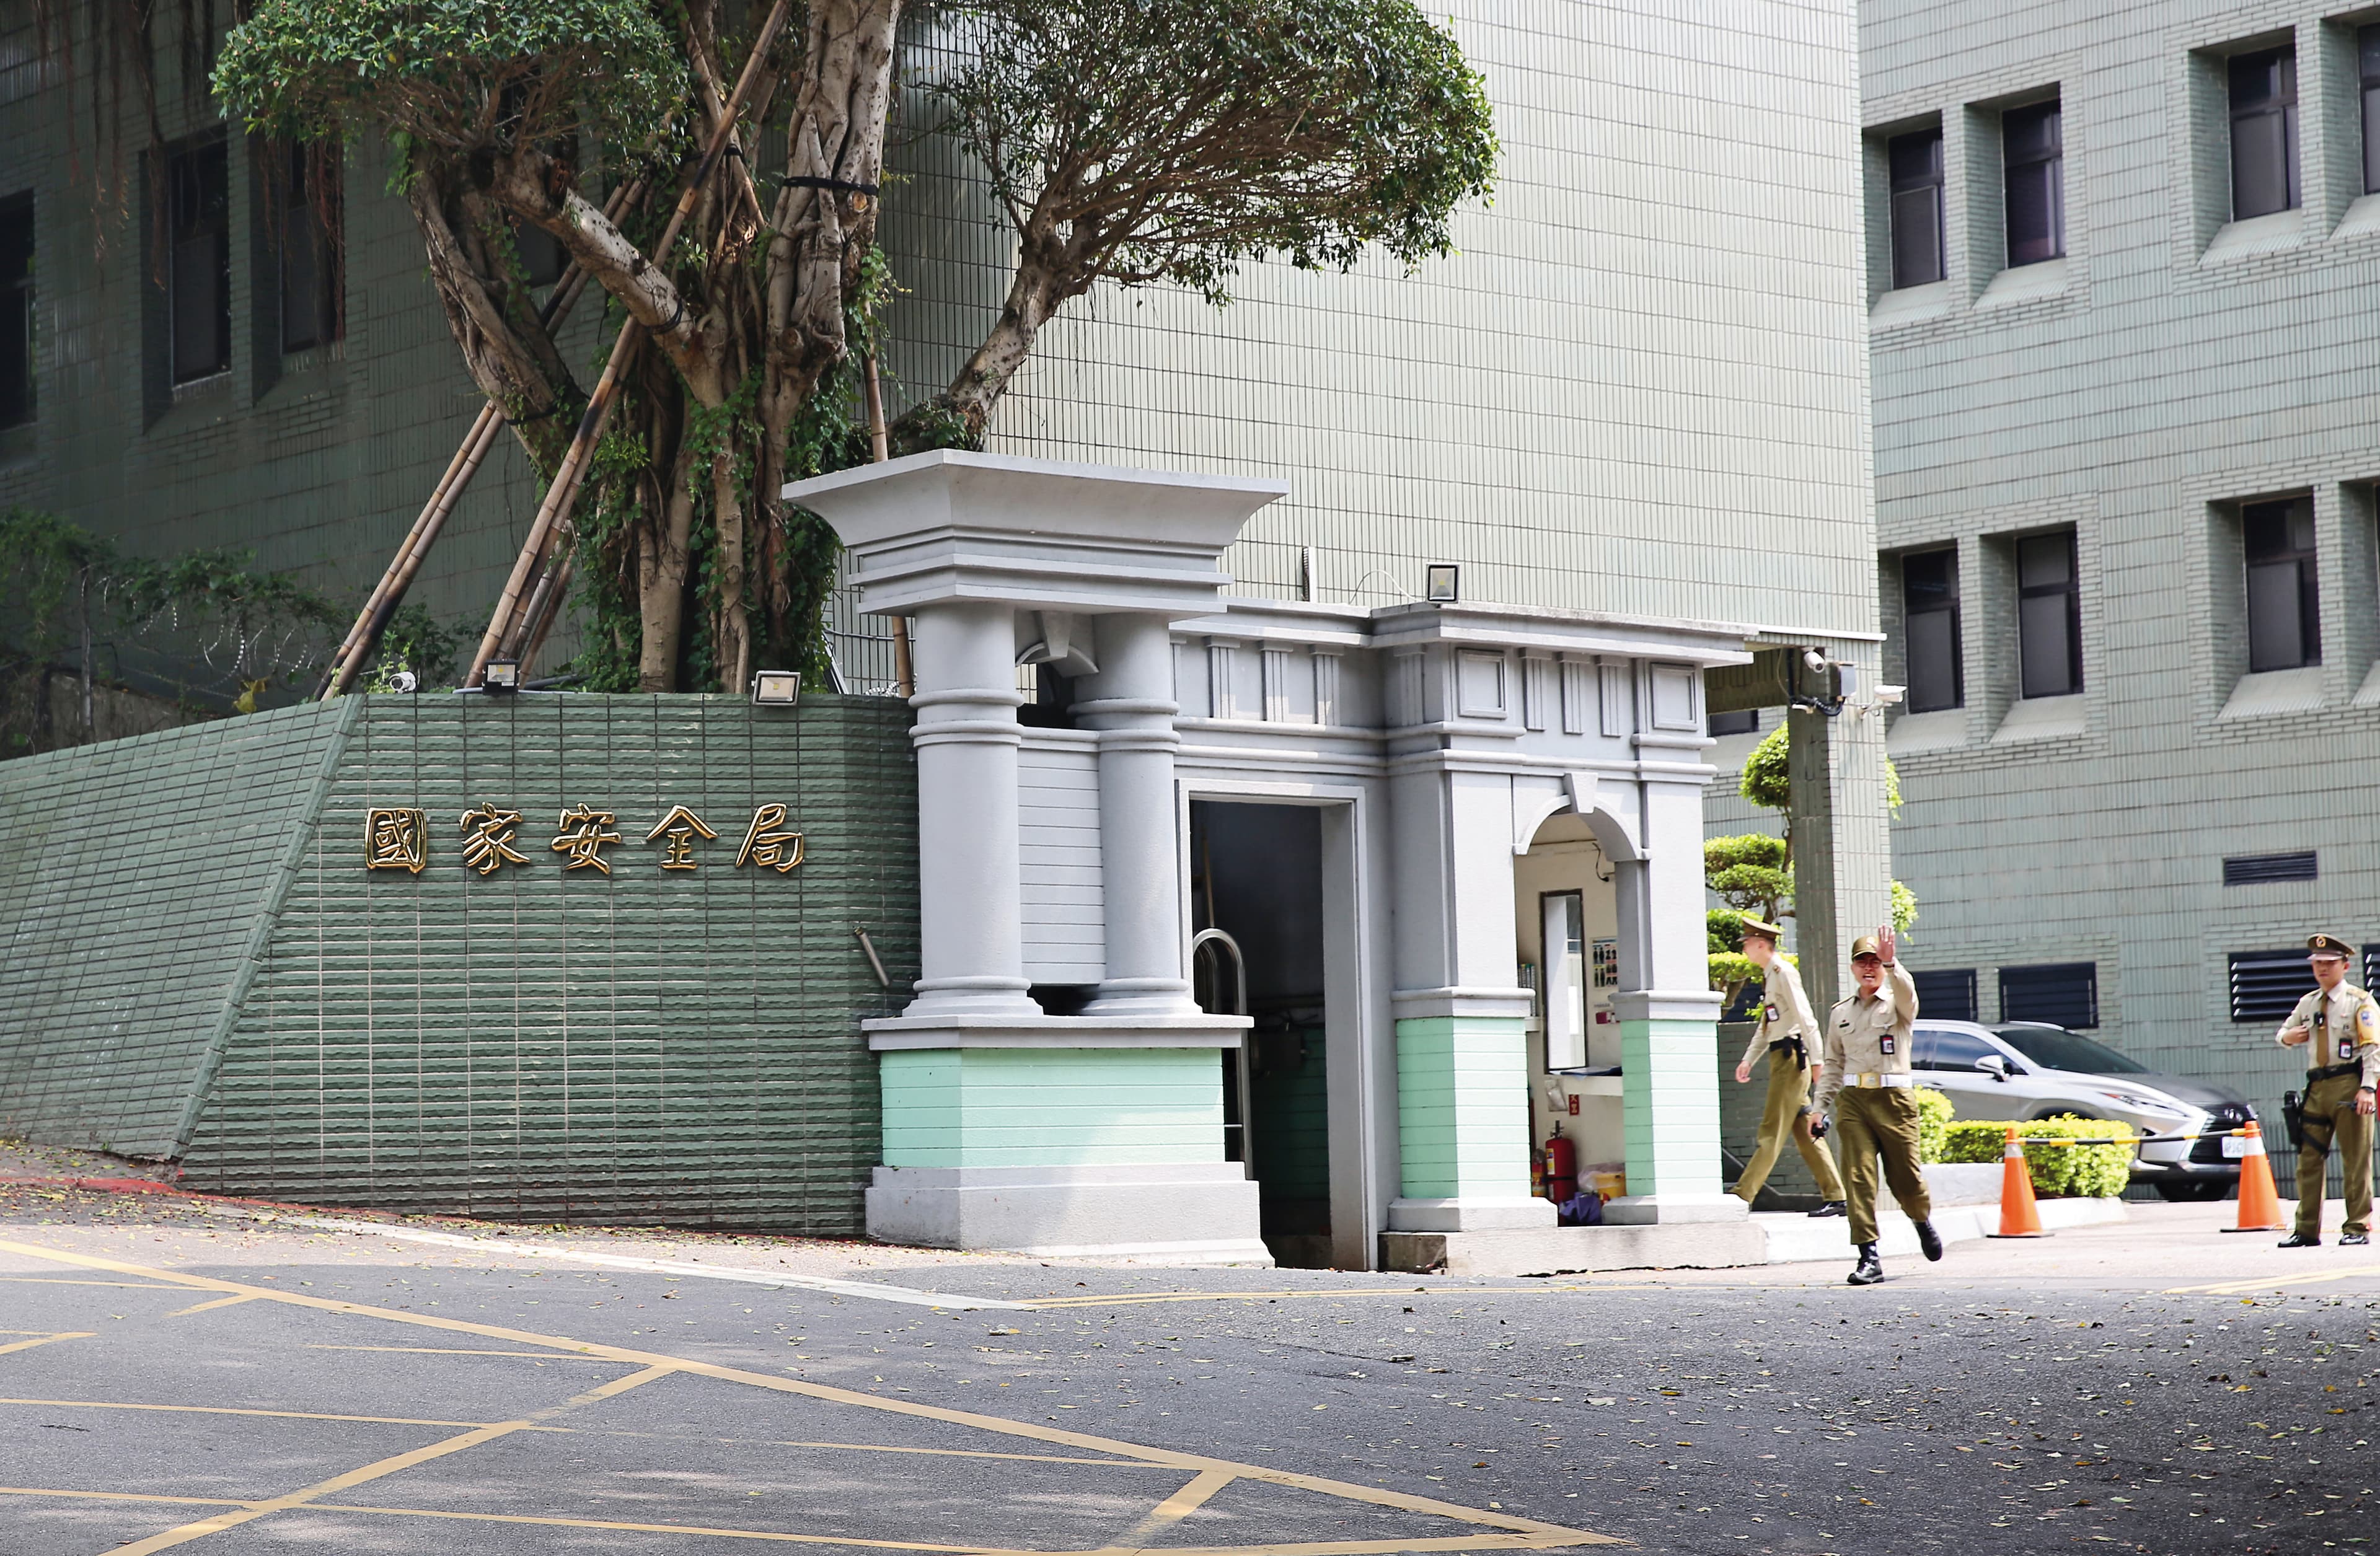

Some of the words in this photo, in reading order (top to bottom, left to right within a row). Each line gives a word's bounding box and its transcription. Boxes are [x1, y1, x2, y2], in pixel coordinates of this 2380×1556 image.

[364, 802, 804, 876] 國家安全局
